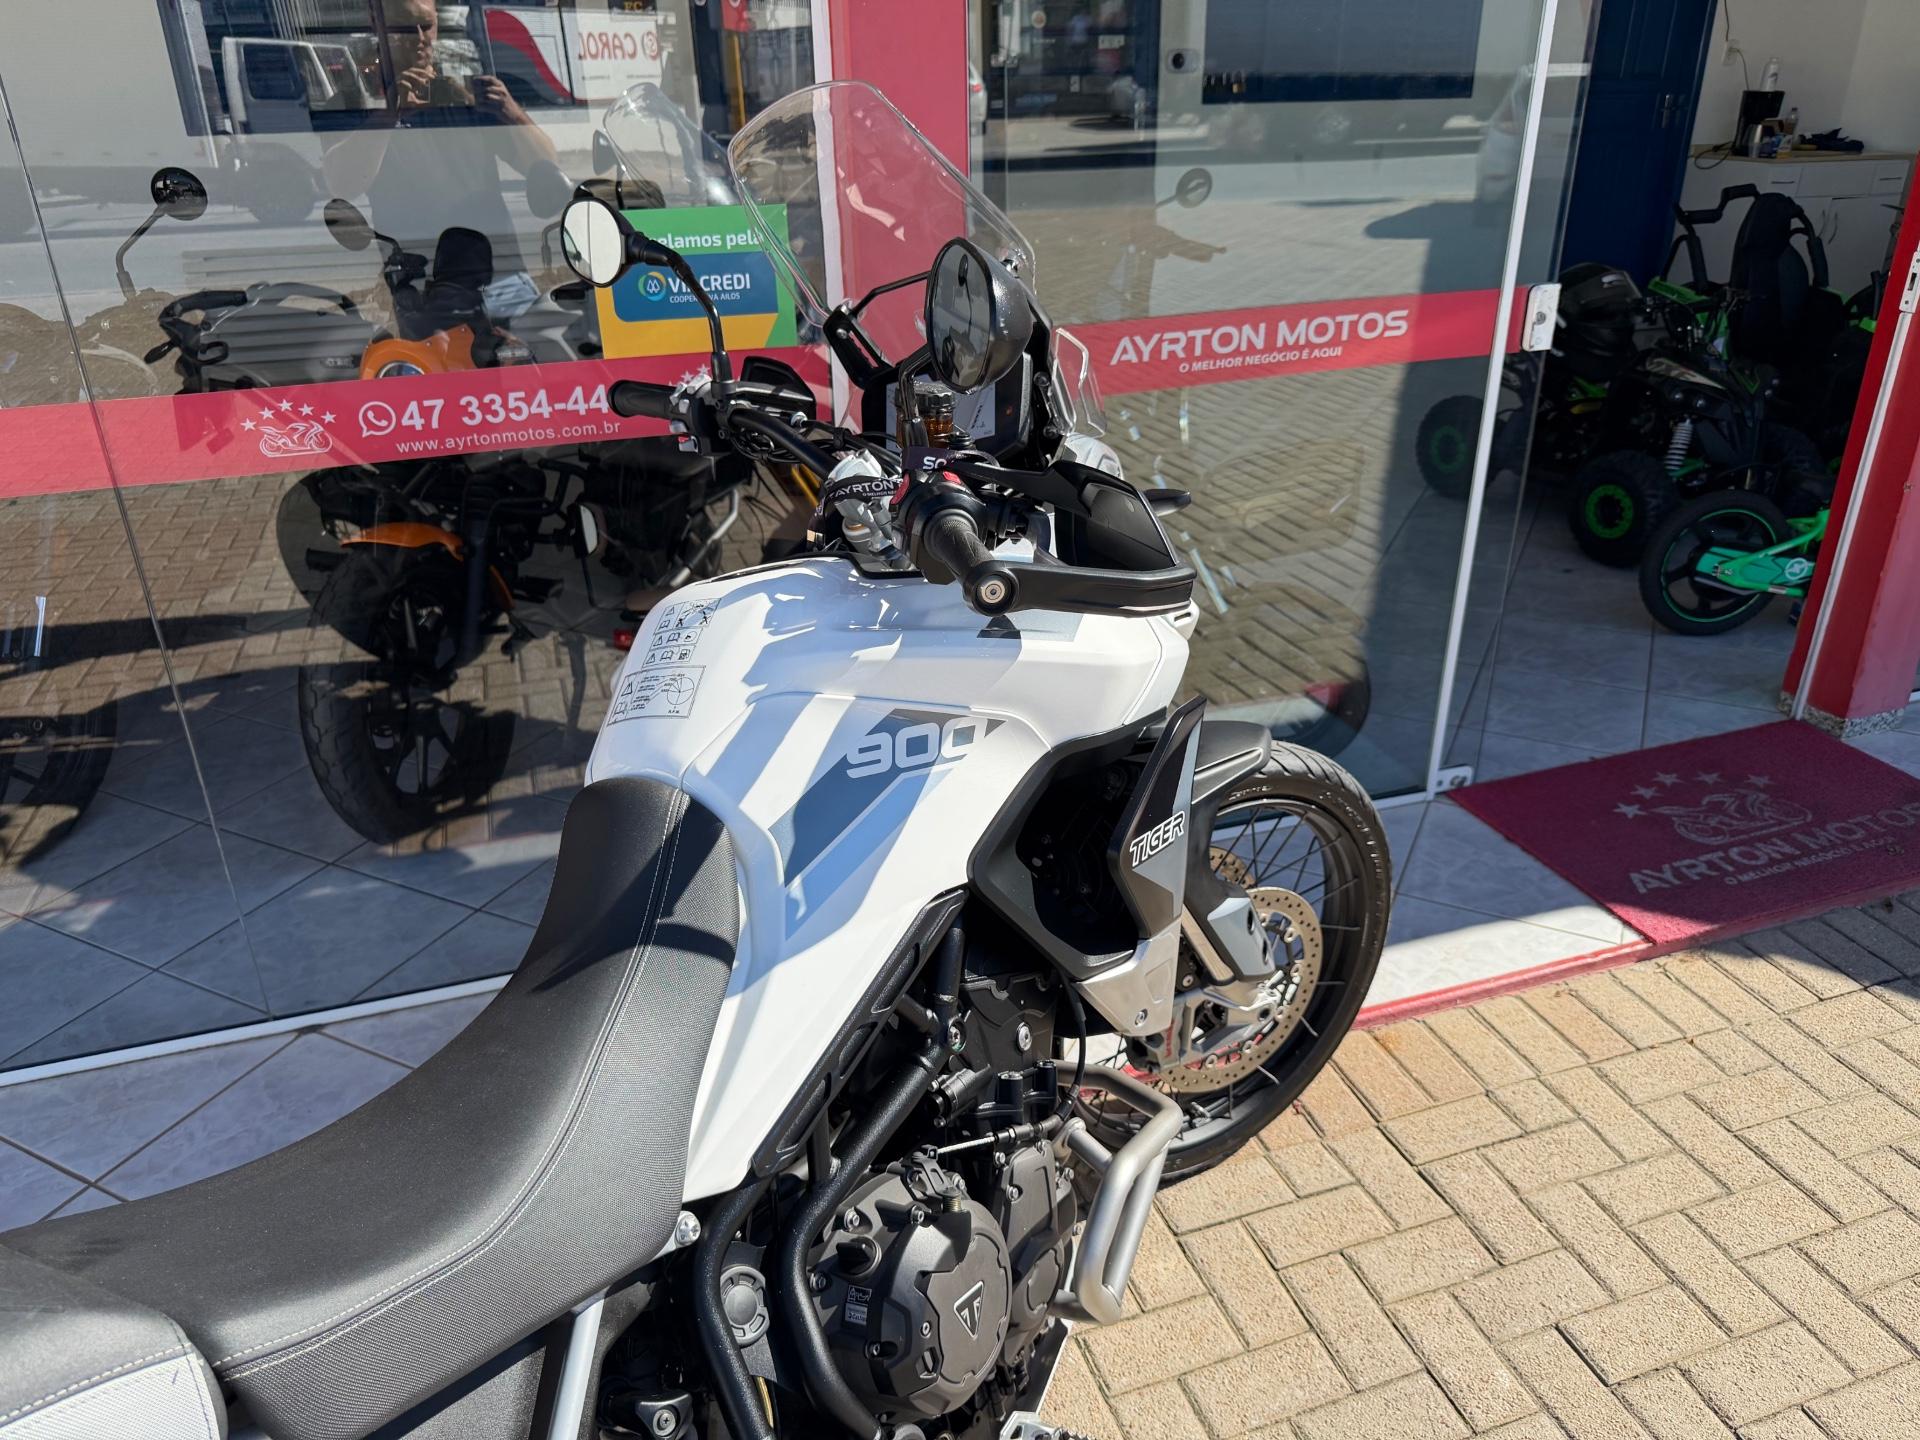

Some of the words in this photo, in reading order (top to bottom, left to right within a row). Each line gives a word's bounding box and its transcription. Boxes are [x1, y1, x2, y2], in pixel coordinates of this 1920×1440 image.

[650, 232, 722, 250] elamos
[668, 273, 751, 294] VICREDI
[669, 292, 719, 304] COOPERVA
[1110, 322, 1266, 365] AYRTON
[1276, 309, 1409, 348] MOTOS
[1179, 362, 1189, 373] O
[1191, 355, 1243, 372] MELHOR
[1244, 350, 1300, 366] NEGÓCIO
[1301, 347, 1310, 359] É
[1311, 346, 1342, 358] AQUI
[401, 398, 445, 431] 47
[459, 383, 609, 427] 3354-44
[396, 420, 621, 454] www.ayrtonmotos.com.br
[835, 480, 894, 497] AYRTON
[846, 716, 985, 779] 900
[1129, 811, 1186, 868] TIGER
[1628, 837, 1801, 894] AYRTON
